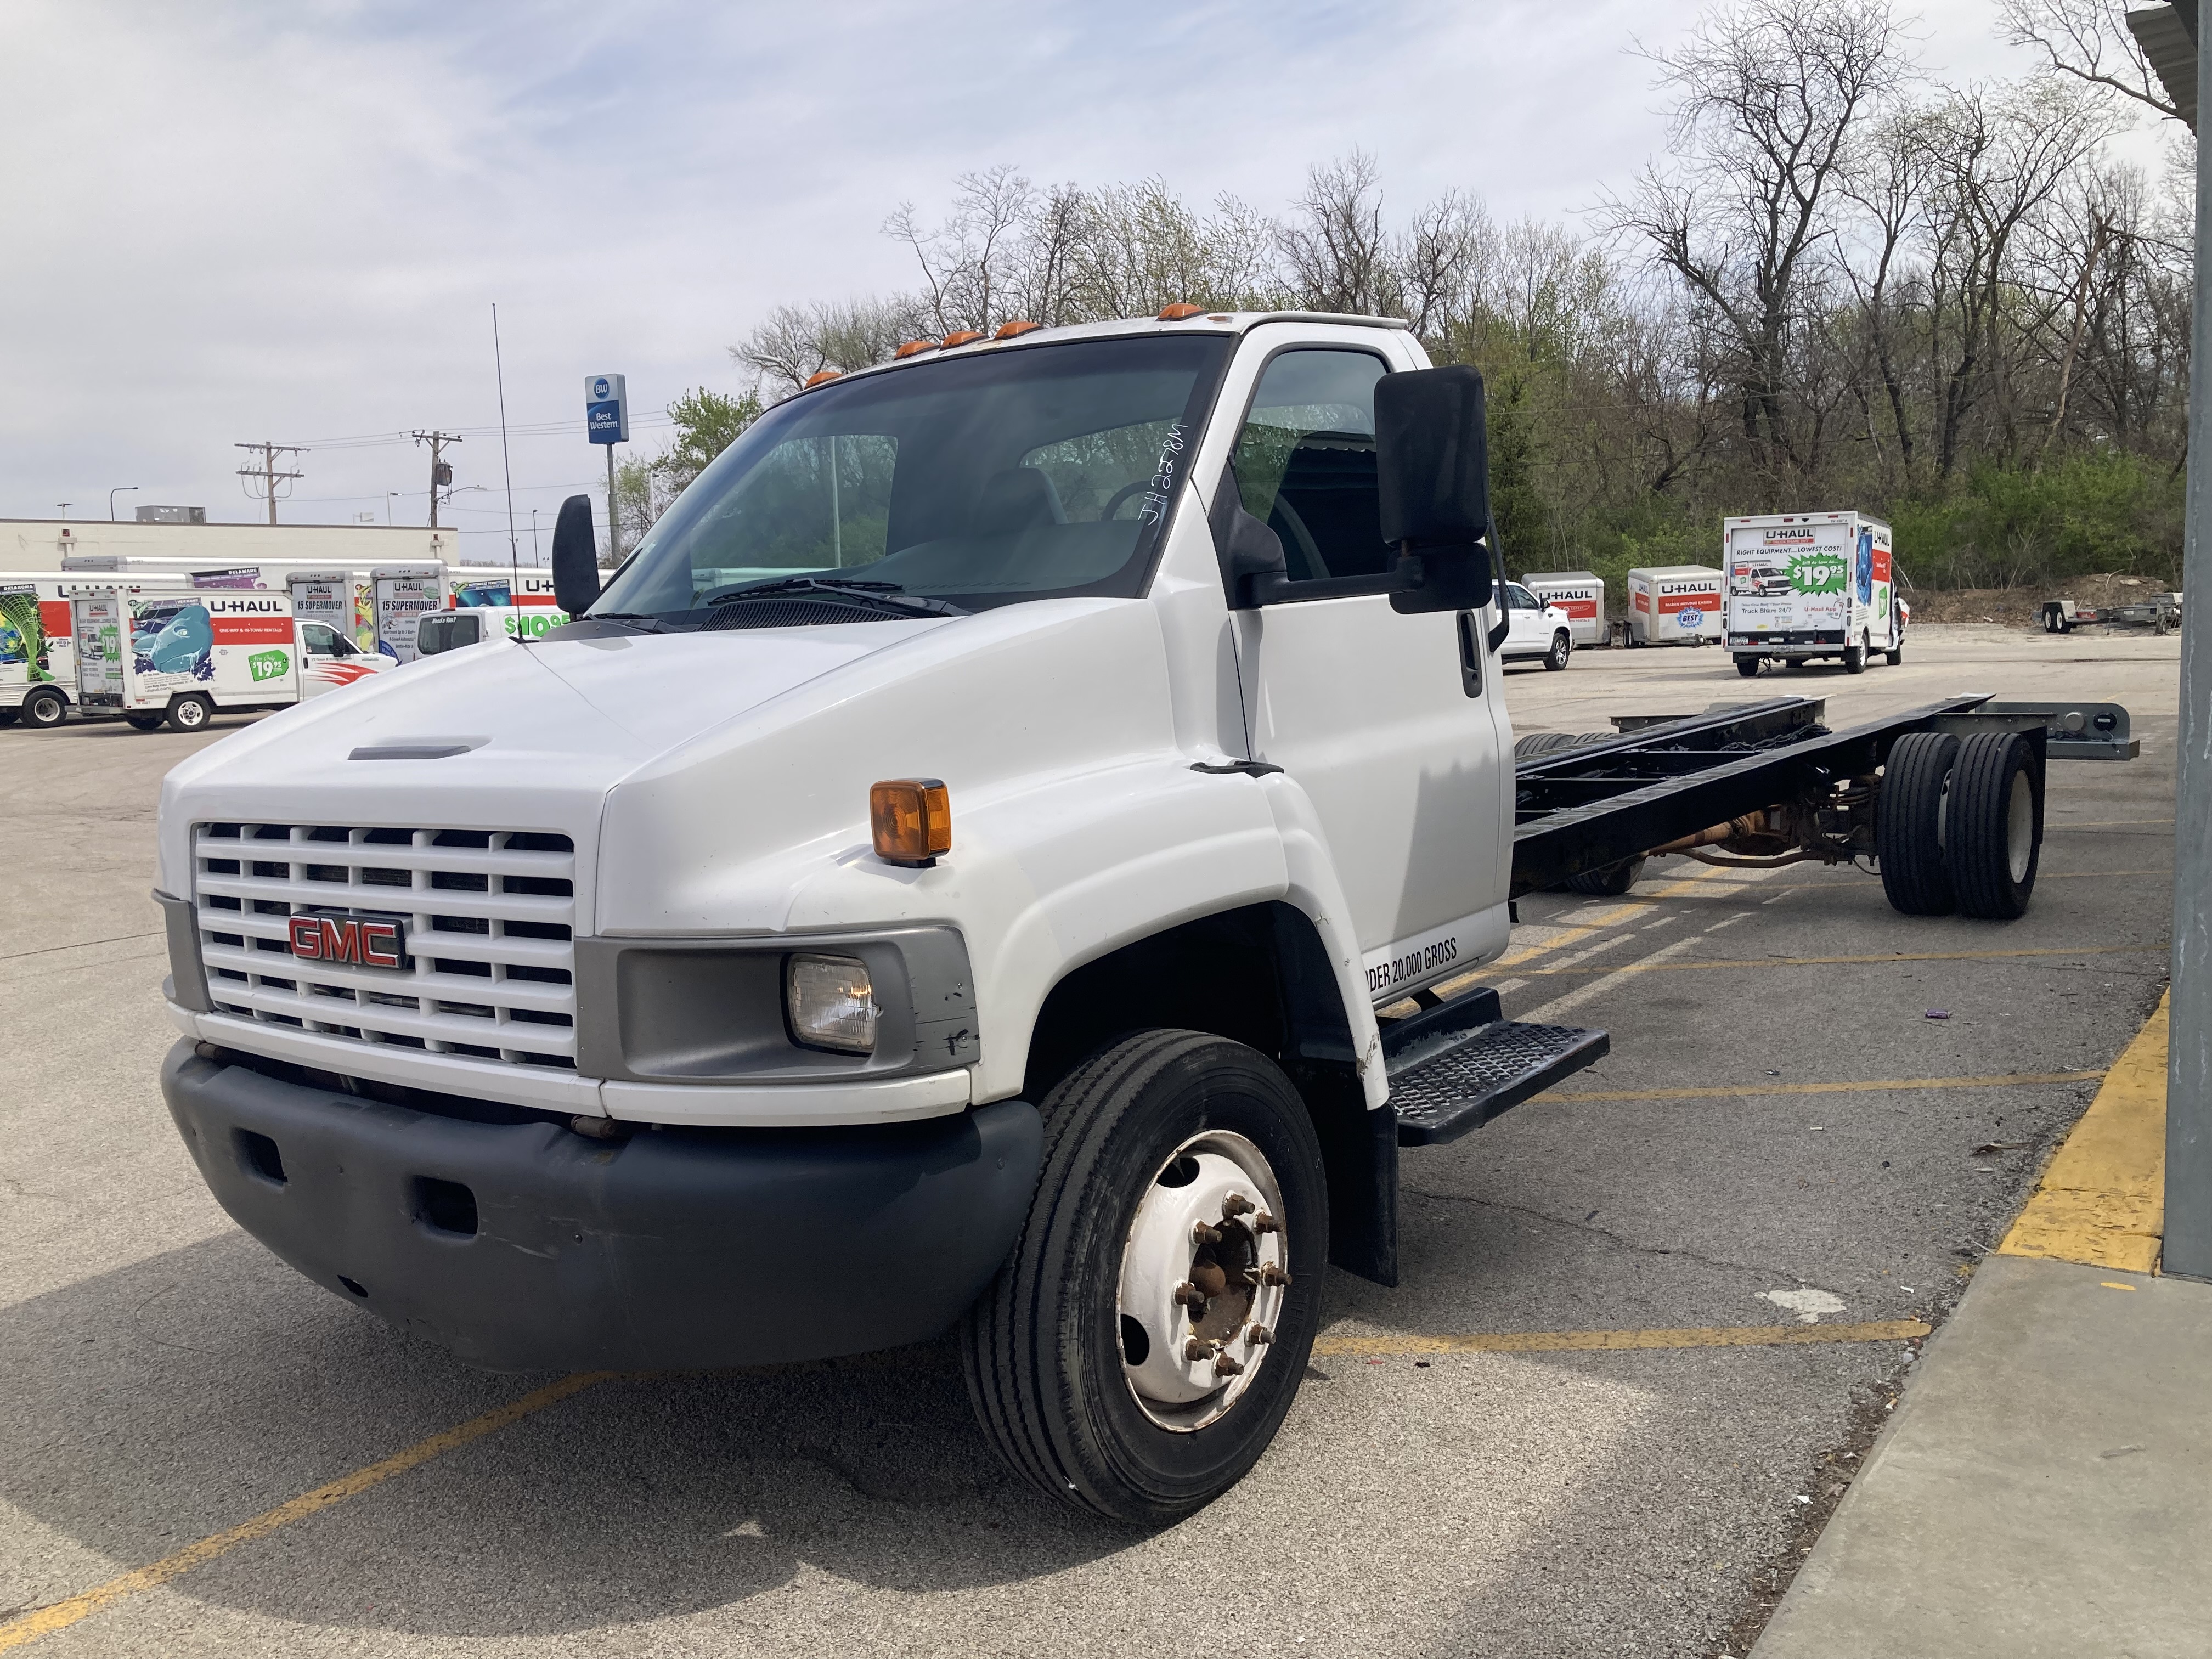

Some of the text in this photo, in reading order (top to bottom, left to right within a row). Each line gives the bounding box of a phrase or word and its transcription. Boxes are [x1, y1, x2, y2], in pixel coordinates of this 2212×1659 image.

[595, 384, 608, 394] BW
[596, 413, 611, 421] Best
[590, 421, 618, 430] Western
[1765, 529, 1813, 538] U-HAUL
[307, 585, 331, 594] U-HAUL
[394, 583, 422, 591] U-HAUL
[1662, 583, 1717, 594] U-HAUL
[1539, 590, 1593, 600] U-HAUL
[210, 601, 283, 612] U-HAUL
[305, 600, 342, 610] SUPERMOVER
[391, 600, 437, 611] SUPERMOVER
[289, 915, 399, 969] GMC
[1392, 951, 1422, 982] 20,000
[1424, 937, 1457, 970] GROSS
